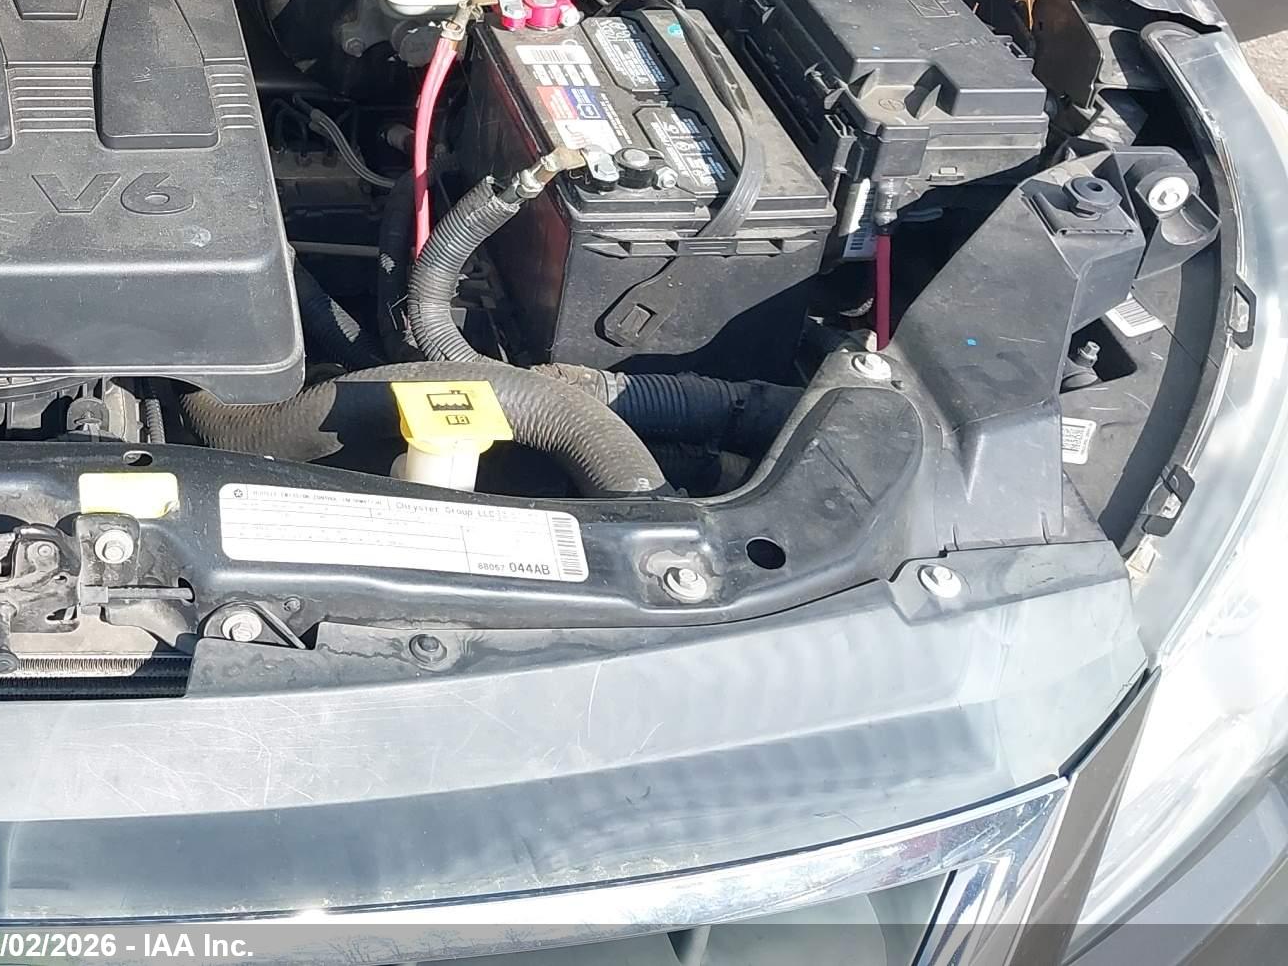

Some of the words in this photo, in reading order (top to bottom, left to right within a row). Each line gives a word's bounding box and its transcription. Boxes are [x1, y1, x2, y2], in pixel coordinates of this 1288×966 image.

[32, 172, 195, 215] V6
[444, 506, 473, 517] Group
[509, 562, 551, 576] 044AB
